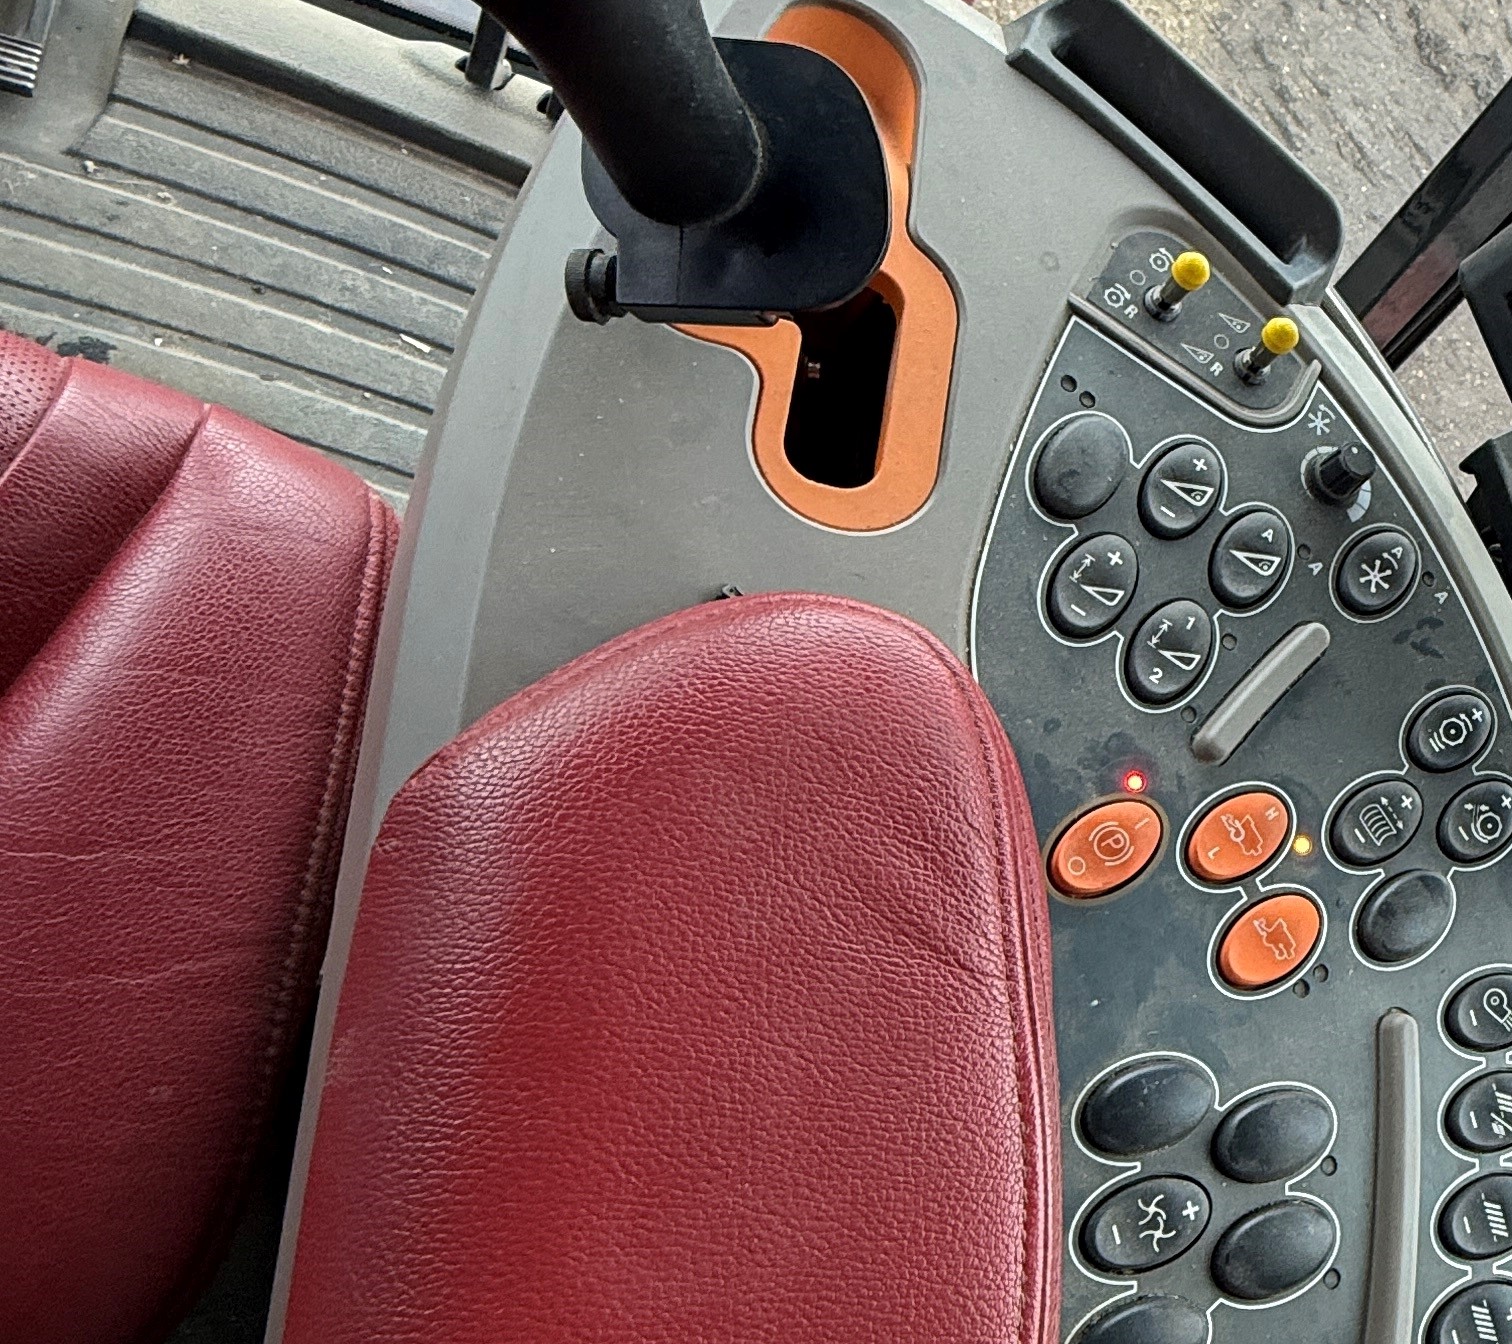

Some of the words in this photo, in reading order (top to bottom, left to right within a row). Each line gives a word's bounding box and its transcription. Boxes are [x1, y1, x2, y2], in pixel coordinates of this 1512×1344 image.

[1124, 304, 1139, 319] R
[1209, 362, 1224, 377] R
[1261, 529, 1274, 543] A
[1391, 546, 1404, 559] A
[1308, 562, 1324, 576] A
[1434, 591, 1449, 604] A
[1186, 617, 1196, 630] 1
[1149, 667, 1164, 684] 2
[1265, 807, 1280, 821] H
[1101, 833, 1126, 849] P
[1208, 847, 1221, 860] L
